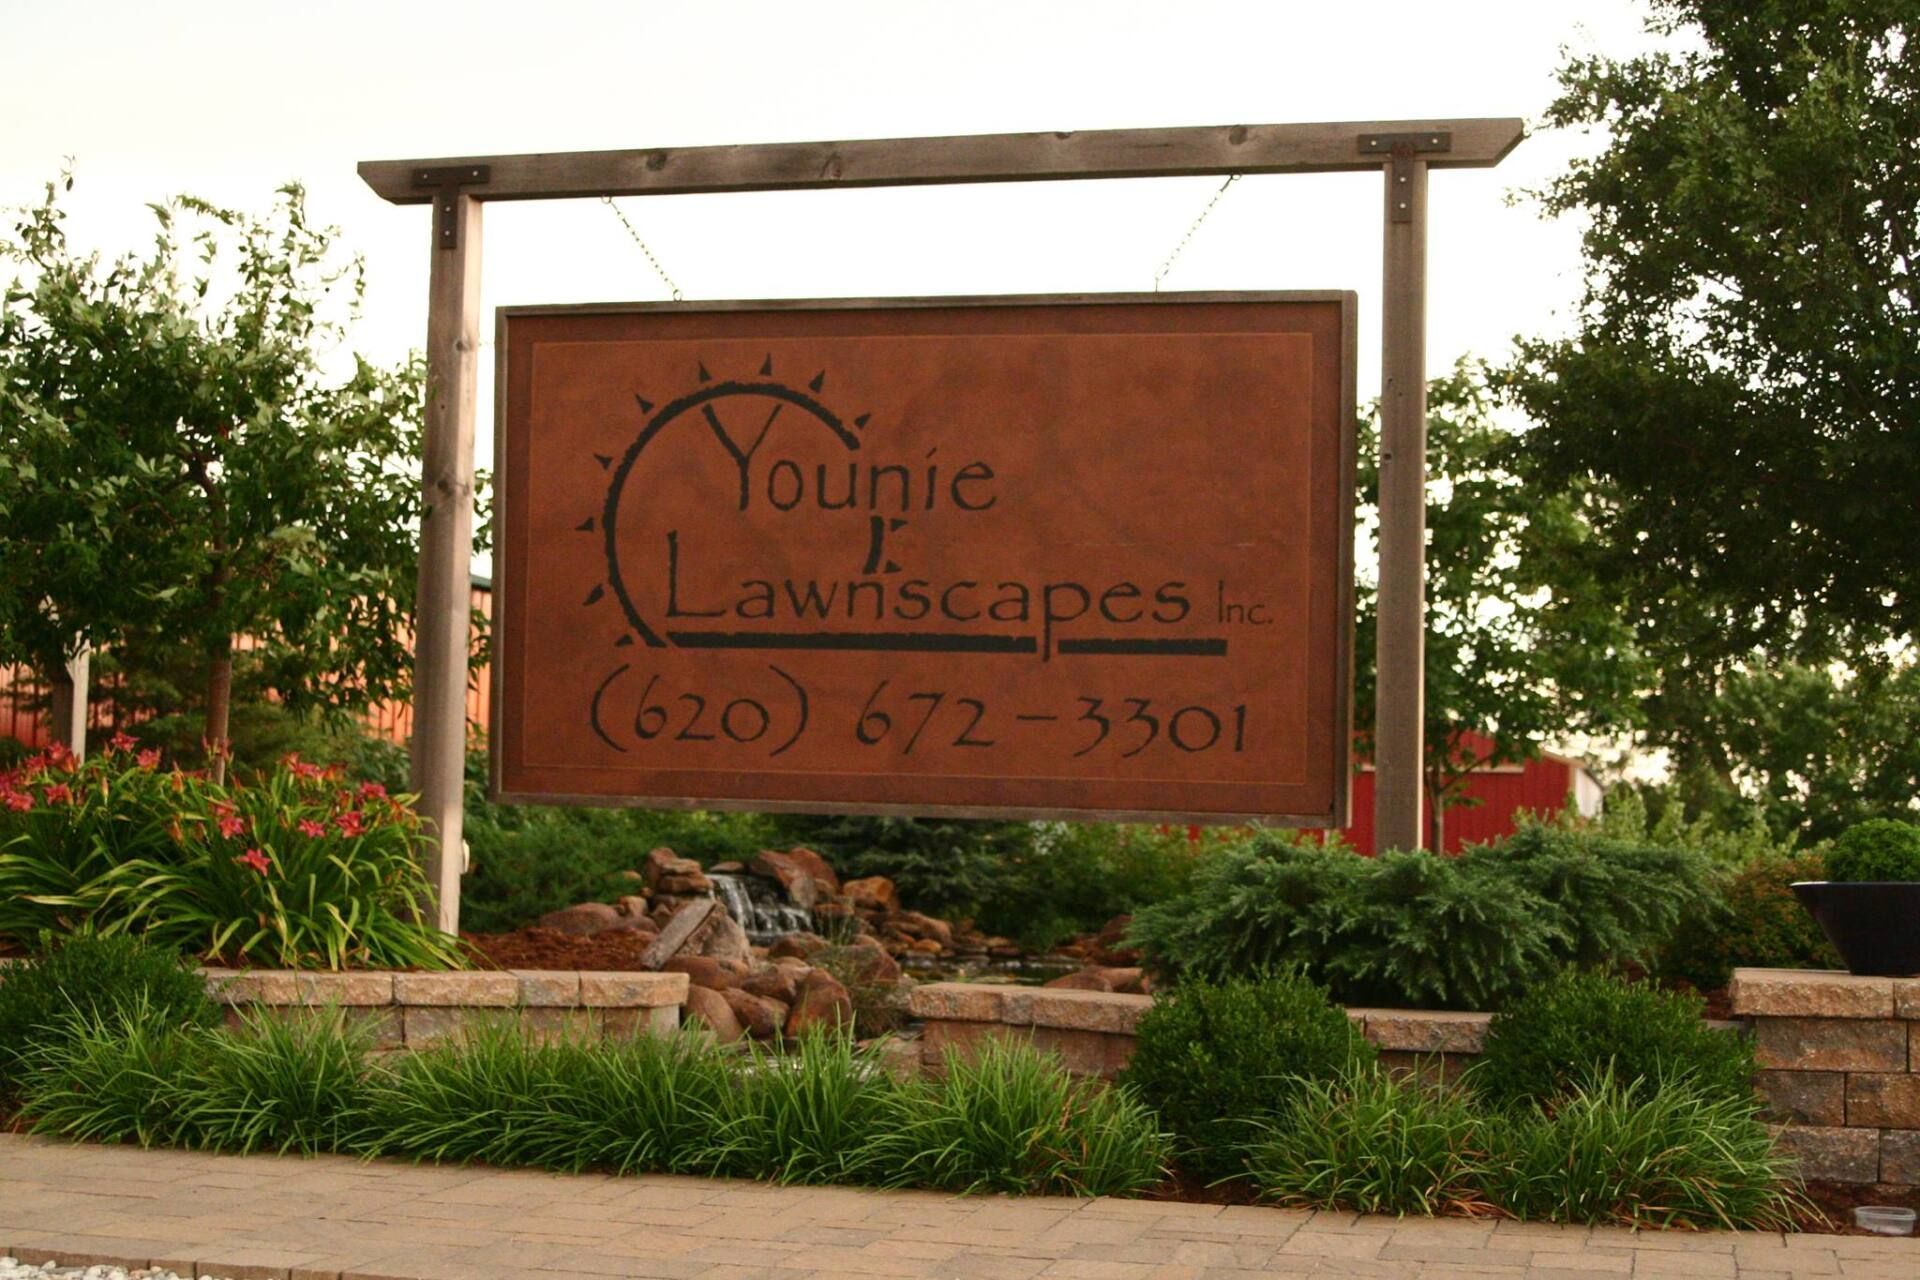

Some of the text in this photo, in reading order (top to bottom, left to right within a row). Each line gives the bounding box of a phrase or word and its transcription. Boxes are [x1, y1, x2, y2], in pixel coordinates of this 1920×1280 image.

[702, 402, 998, 512] Younie
[665, 530, 1274, 662] Lawnscapes Inc.
[590, 663, 809, 756] (620)
